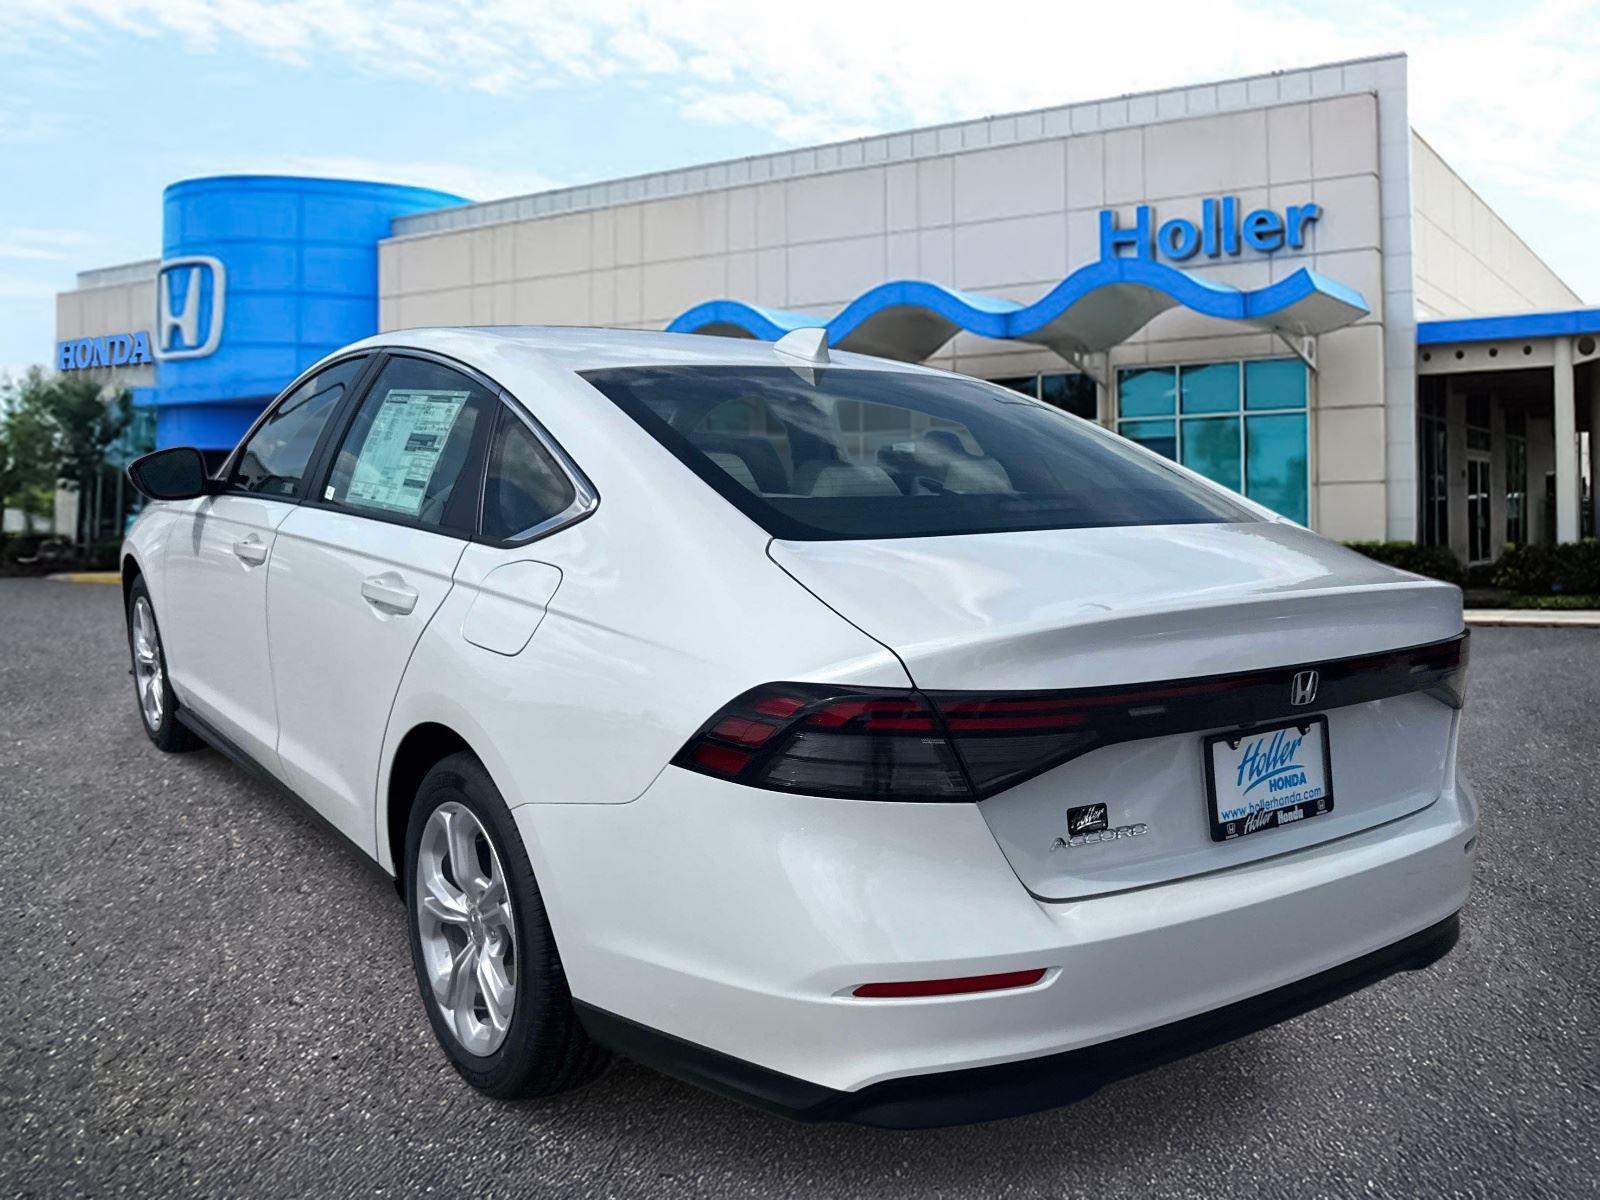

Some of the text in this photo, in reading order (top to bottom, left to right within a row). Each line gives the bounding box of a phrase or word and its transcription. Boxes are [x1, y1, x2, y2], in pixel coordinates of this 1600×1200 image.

[1099, 196, 1322, 262] Holler
[57, 331, 152, 371] HONDA
[1237, 729, 1303, 786] Holler
[1269, 772, 1307, 793] HONDA
[1221, 787, 1321, 820] wwwhollerhonda.com
[1244, 805, 1304, 834] Holler Honda
[1049, 823, 1148, 852] ACCORD
